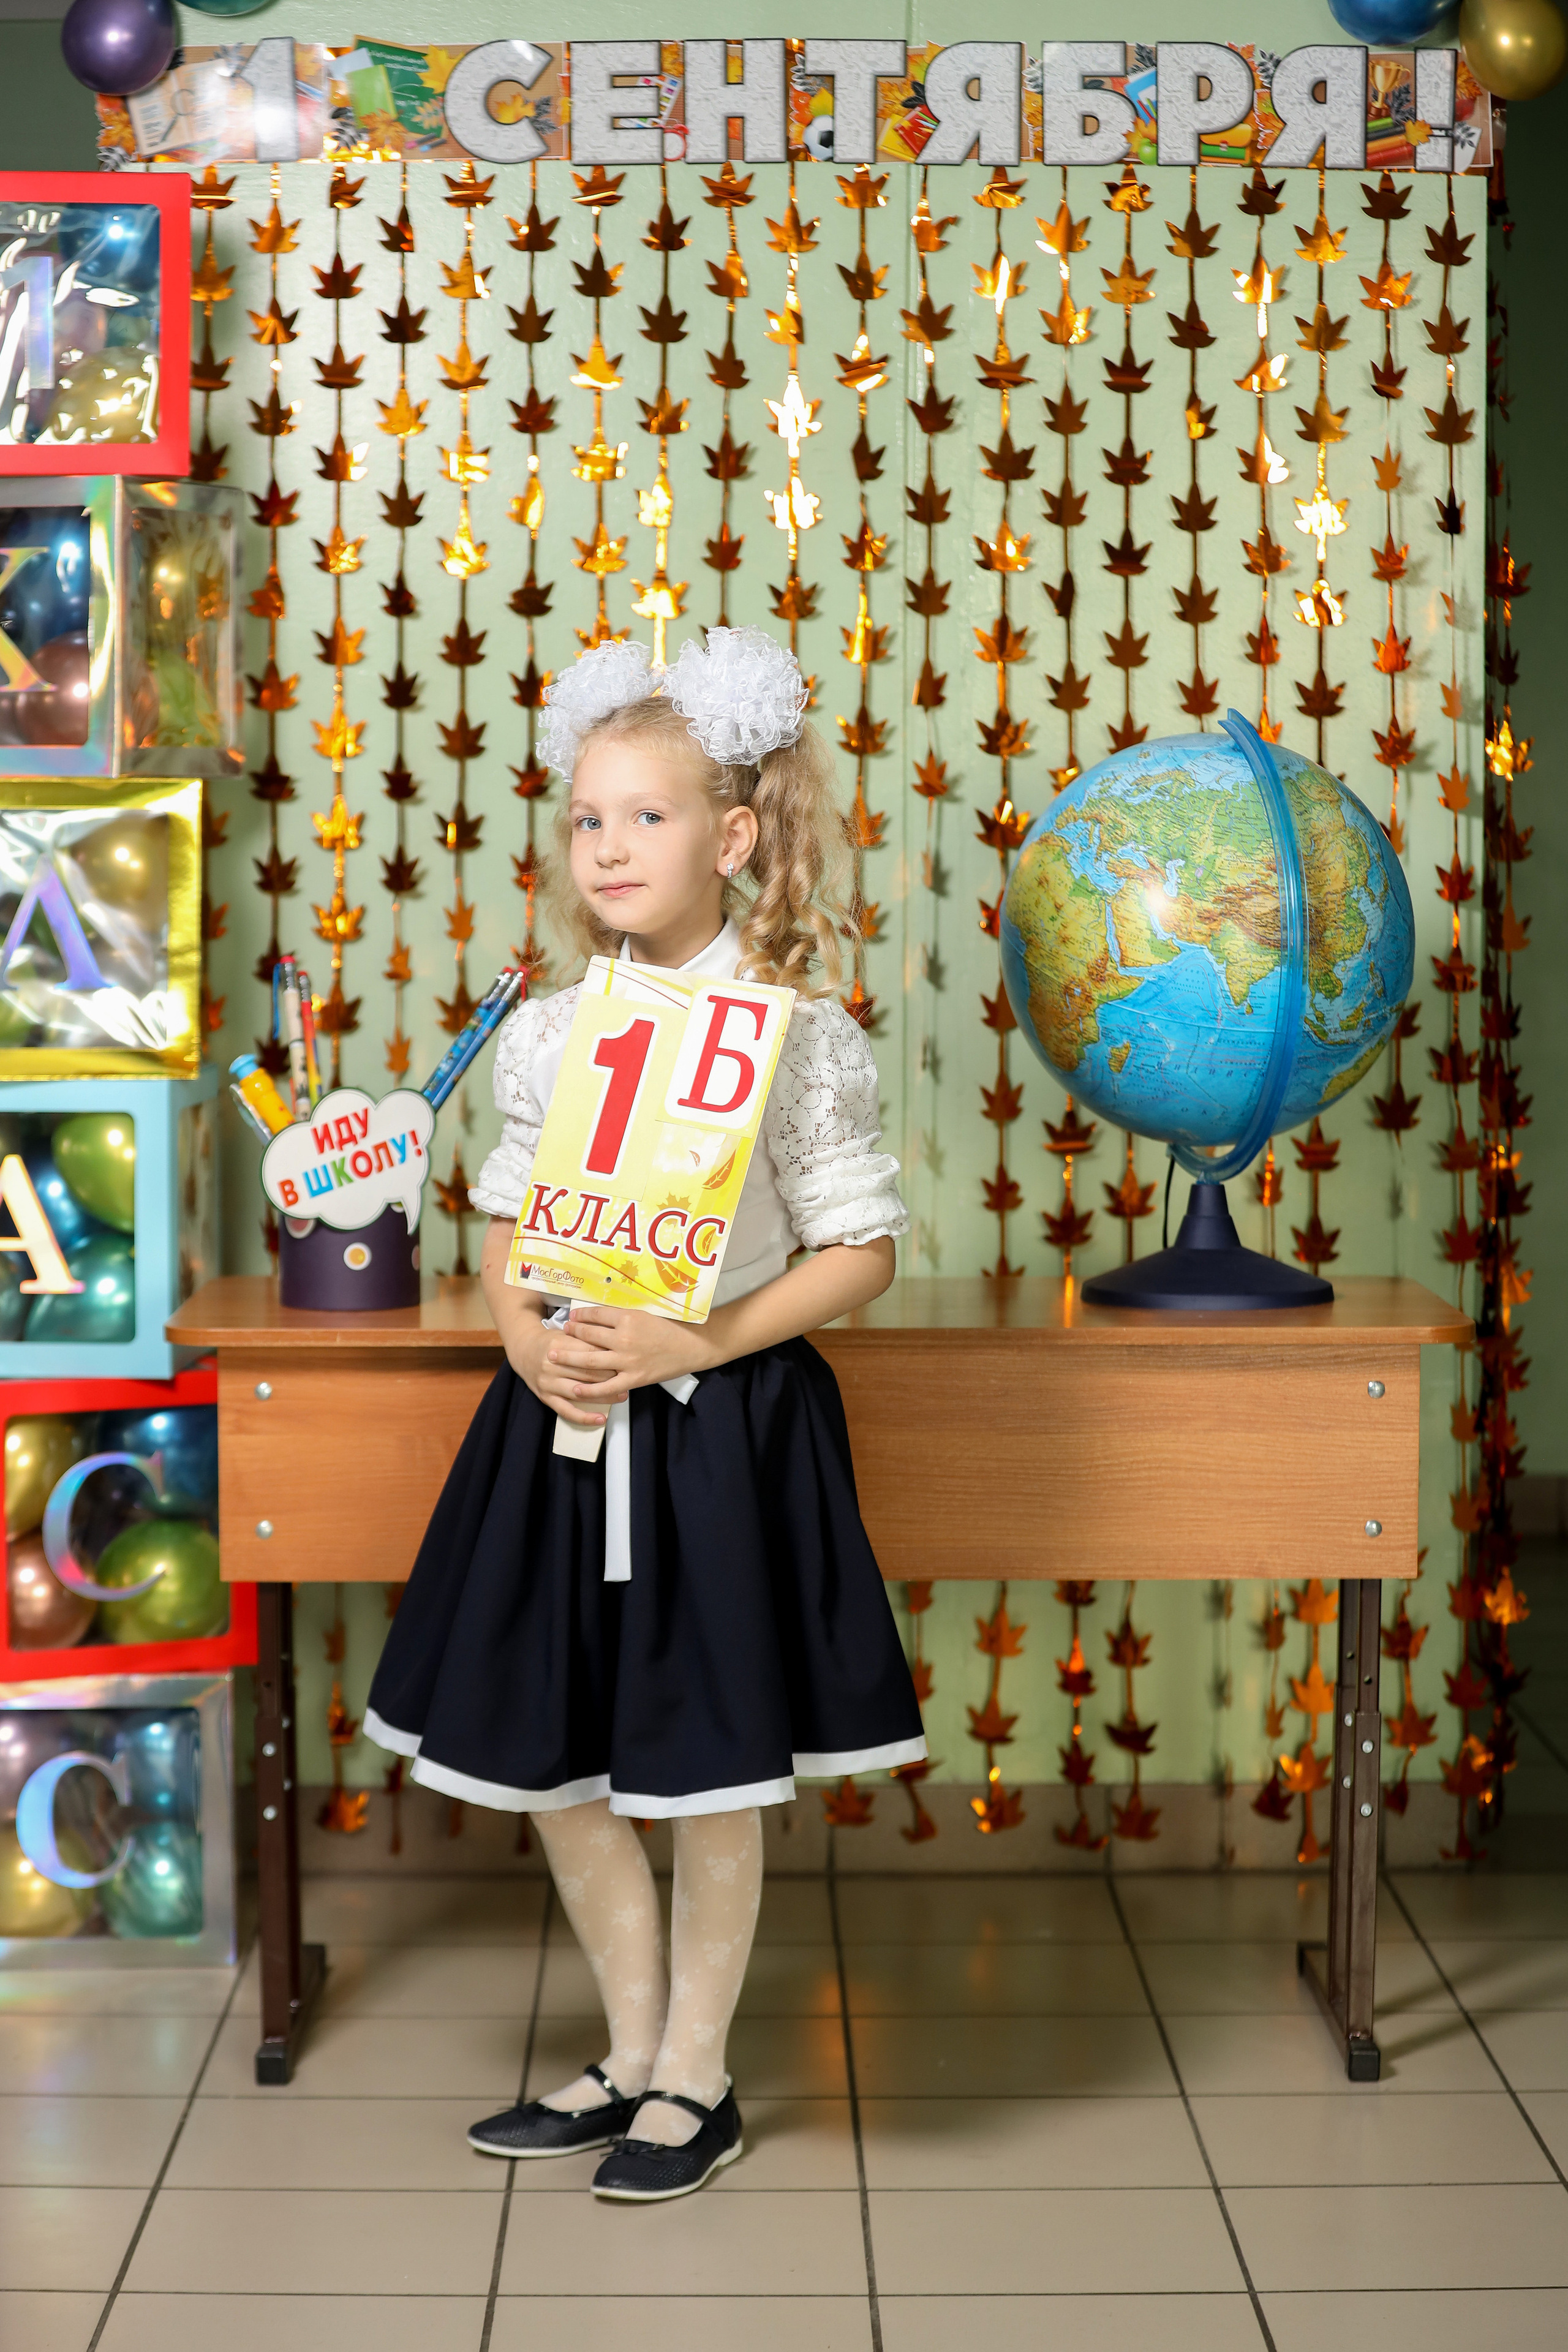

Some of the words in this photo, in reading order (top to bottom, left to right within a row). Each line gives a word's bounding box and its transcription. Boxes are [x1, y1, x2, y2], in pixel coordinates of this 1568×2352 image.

[236, 37, 299, 162] 1
[586, 1019, 655, 1175] 1
[677, 995, 769, 1113] Б
[277, 1179, 299, 1208] В
[302, 1129, 423, 1199] ШКОЛУ!
[311, 1107, 369, 1155] ИДУ
[522, 1183, 726, 1267] КЛАСС
[531, 1265, 584, 1284] МосГорФото
